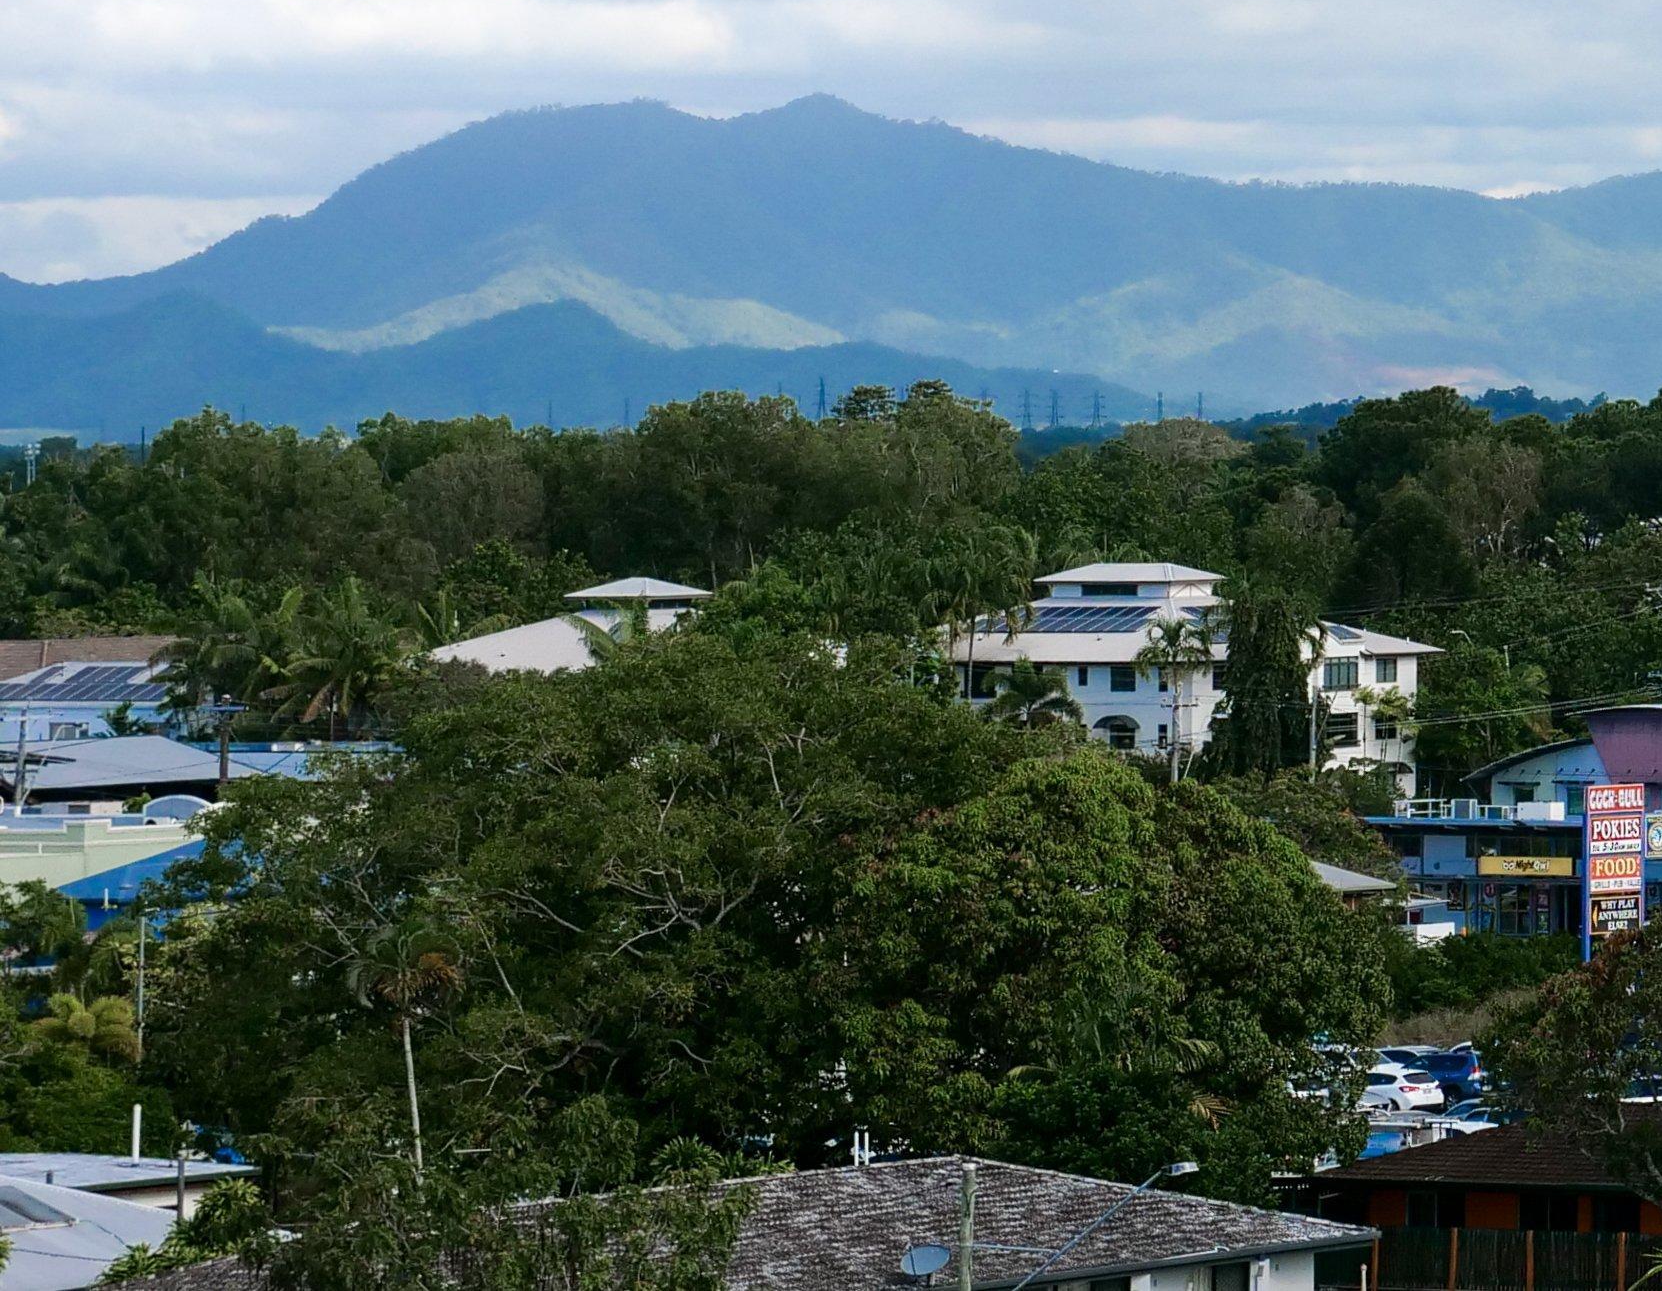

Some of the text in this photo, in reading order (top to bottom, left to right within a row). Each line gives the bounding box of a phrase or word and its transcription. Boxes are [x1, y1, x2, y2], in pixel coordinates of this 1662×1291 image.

[1592, 818, 1640, 840] POKIES
[1595, 857, 1637, 877] FOOD
[1601, 899, 1635, 910] WHY PLAY
[1598, 909, 1638, 921] ANYWHERE
